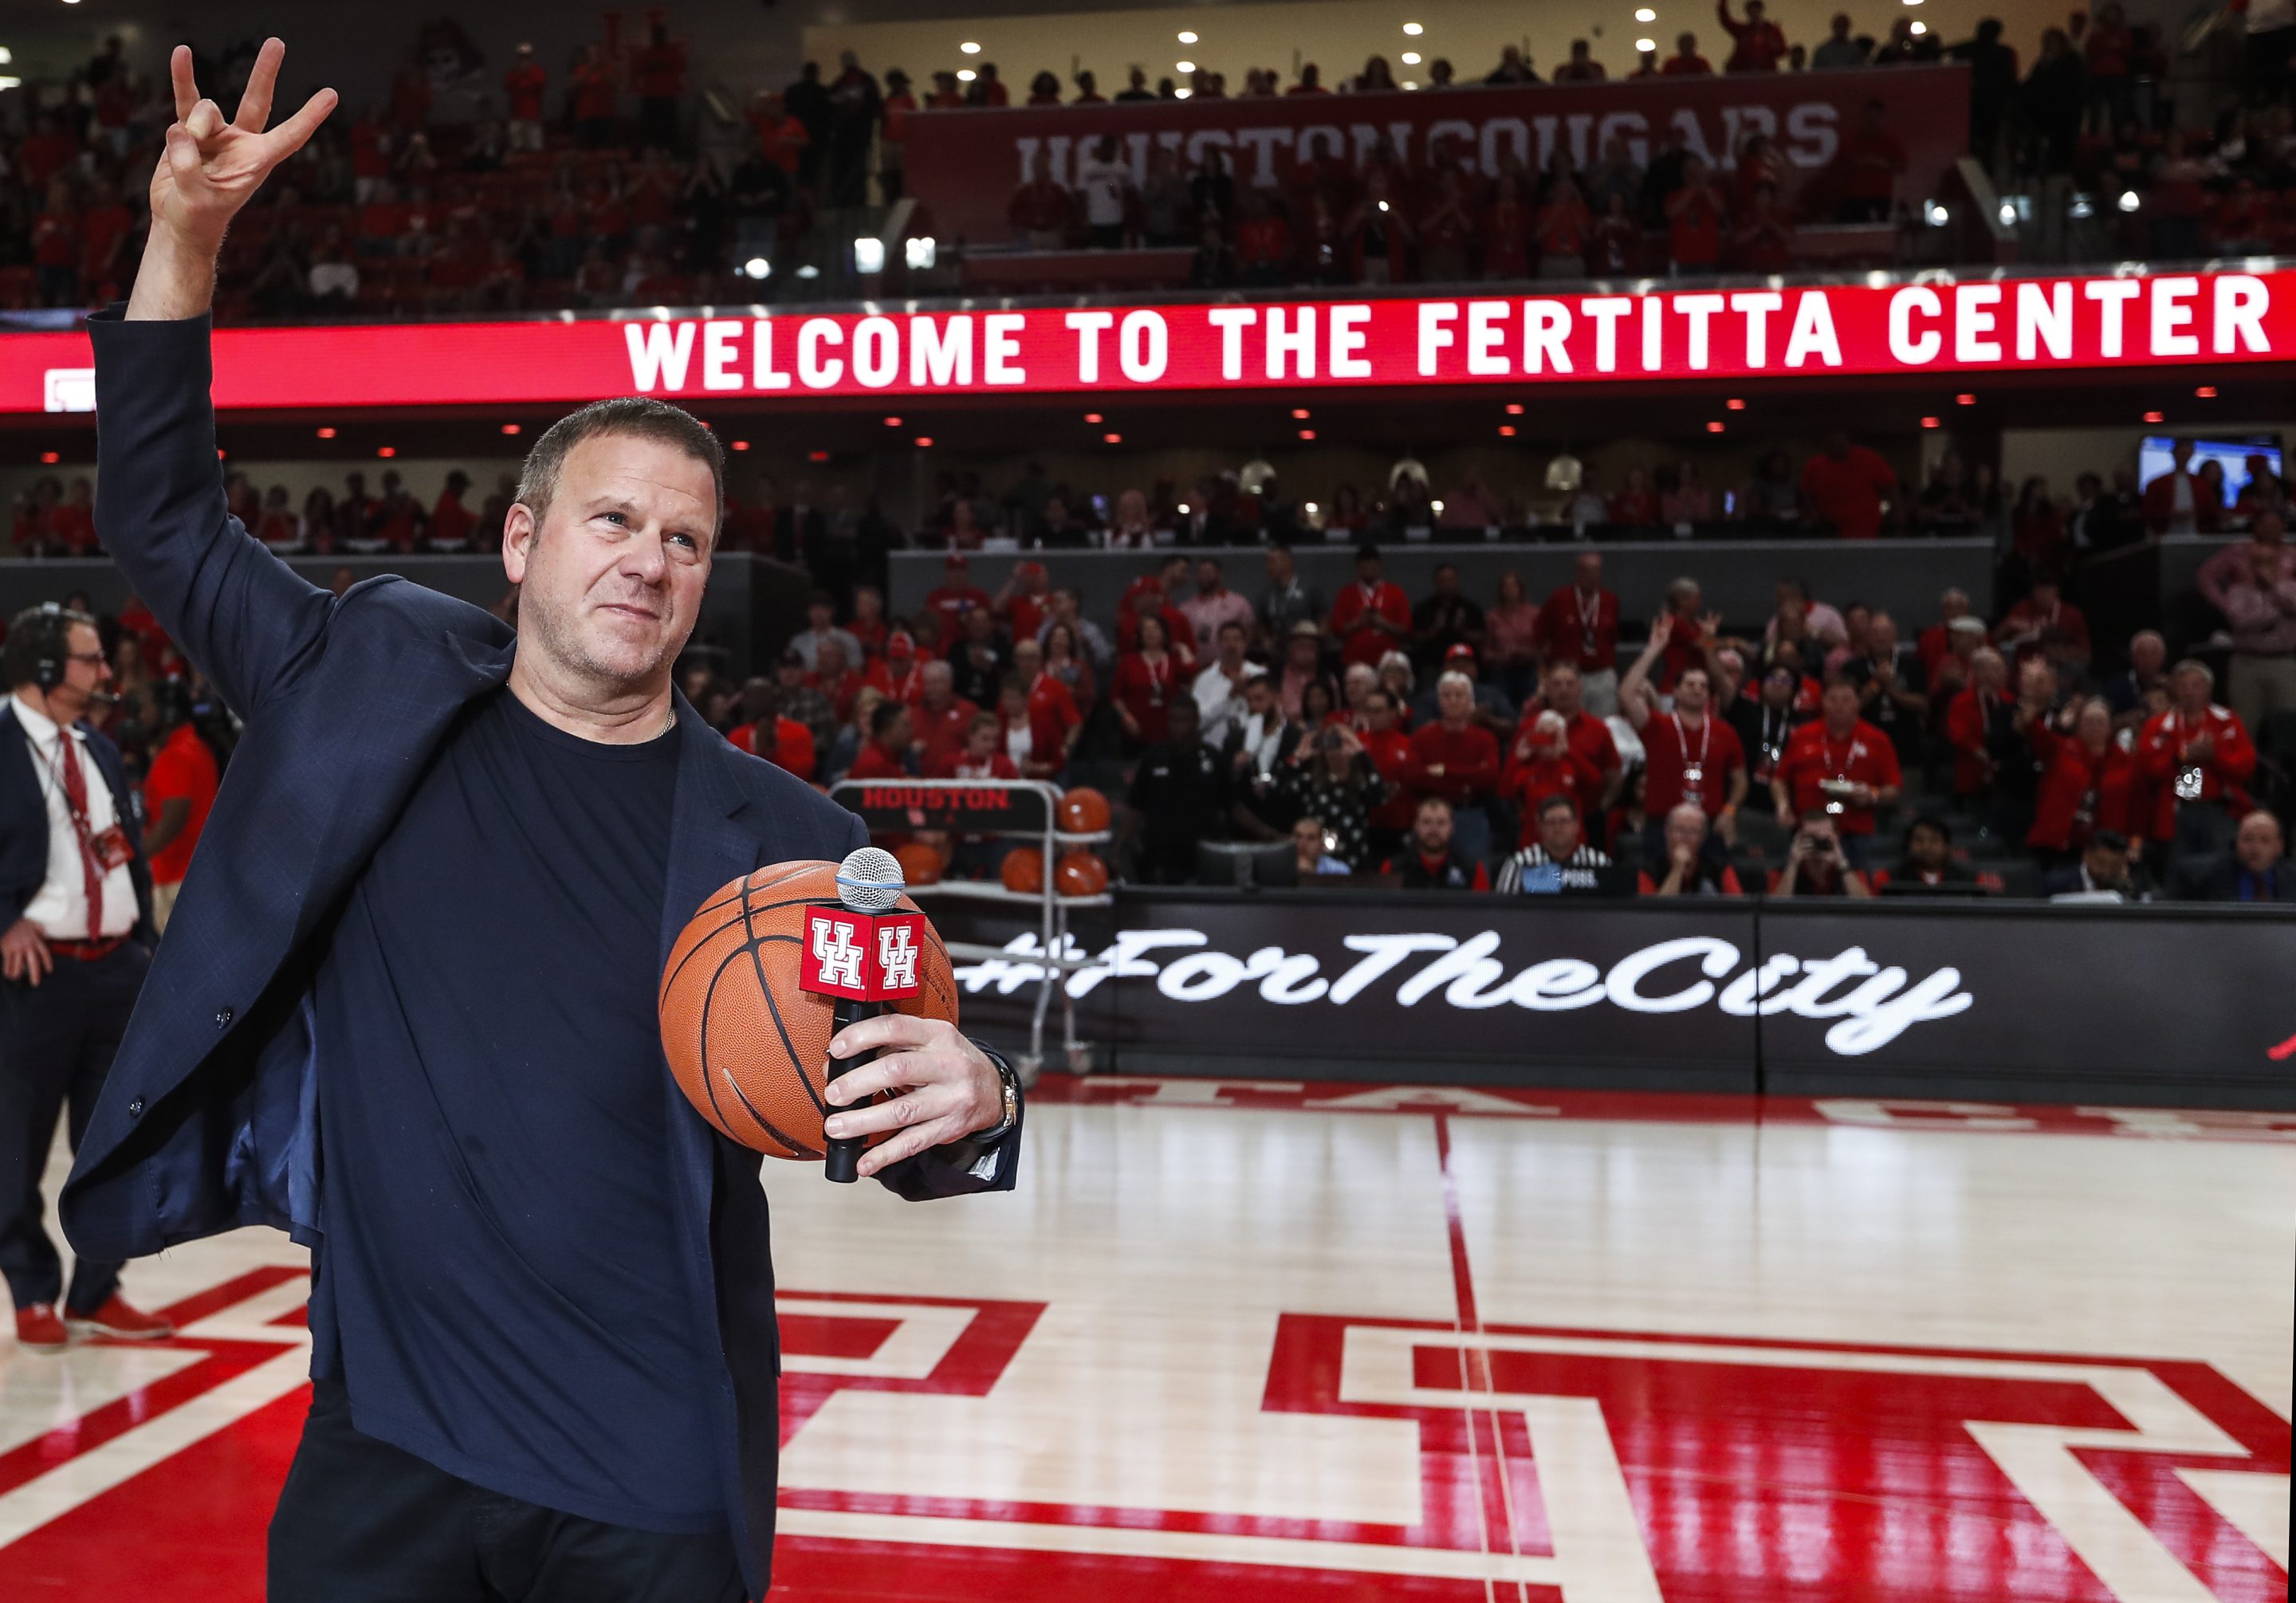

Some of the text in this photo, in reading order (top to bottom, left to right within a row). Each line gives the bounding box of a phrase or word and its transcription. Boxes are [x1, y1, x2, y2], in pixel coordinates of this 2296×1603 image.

[623, 275, 2272, 392] WELCOME TO THE FERTITTA CENTER
[863, 787, 1009, 810] HOUSTON
[953, 929, 1974, 1056] #ForTheCity
